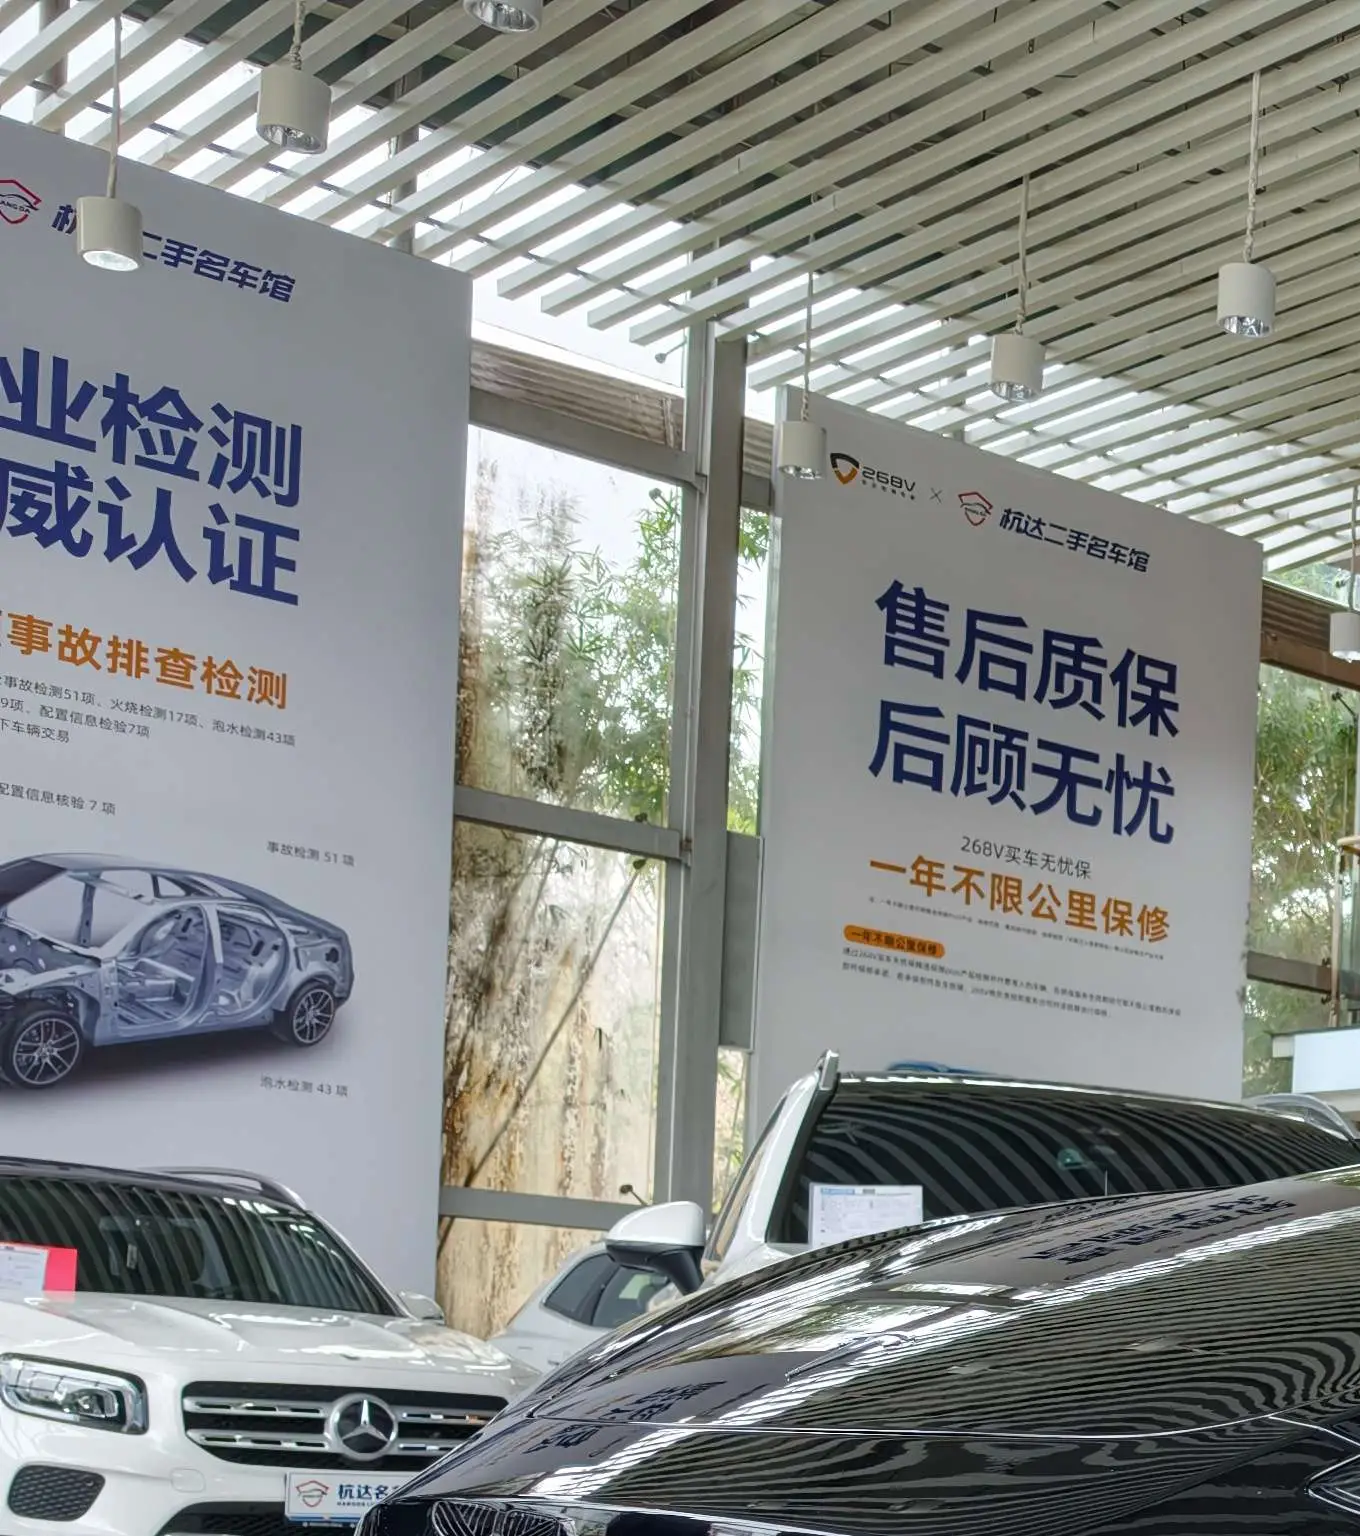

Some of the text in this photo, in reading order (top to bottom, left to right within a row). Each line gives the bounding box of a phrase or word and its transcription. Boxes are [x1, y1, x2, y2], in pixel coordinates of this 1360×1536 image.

[0, 346, 303, 507] 业检测
[862, 466, 916, 492] 268V
[0, 458, 299, 606] 威认证
[999, 507, 1150, 573] 杭达二手名车馆
[0, 611, 288, 710] 事故排查检测
[874, 579, 1180, 738] 售后质保
[867, 699, 1176, 846] 后顾无忧
[868, 854, 1171, 944] 一年不限公里保修
[960, 835, 1093, 880] 268V买车无忧保
[337, 1484, 401, 1501] 杭达名
